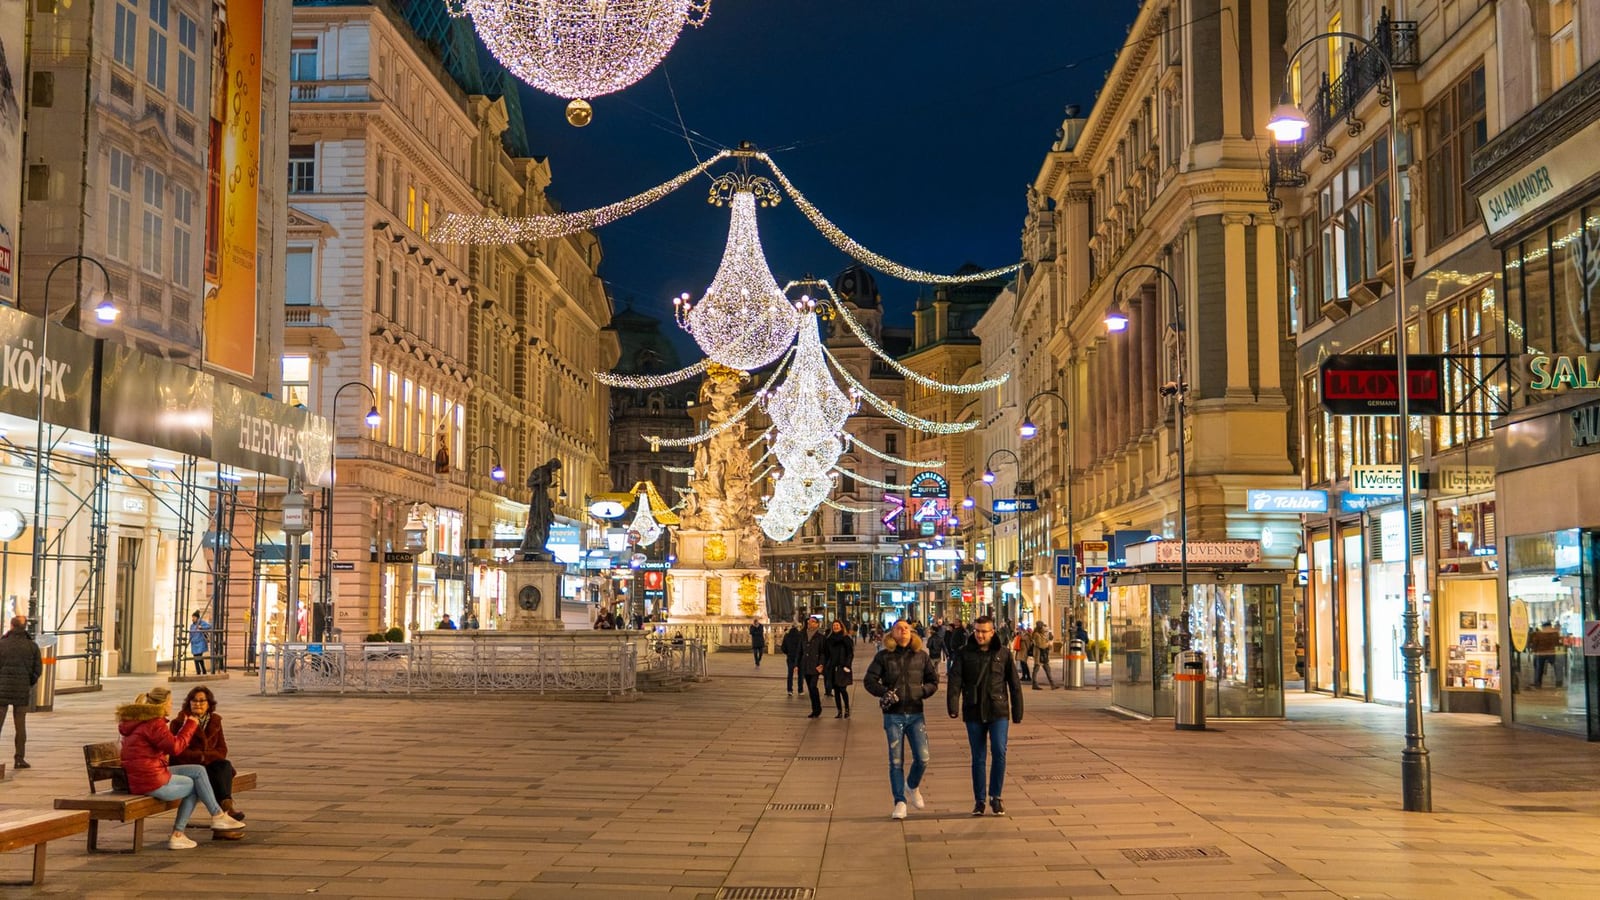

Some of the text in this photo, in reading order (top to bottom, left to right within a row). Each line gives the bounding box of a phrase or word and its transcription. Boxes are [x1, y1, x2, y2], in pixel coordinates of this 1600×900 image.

[1488, 166, 1554, 222] SALAMANDER
[3, 338, 67, 402] KÖCK
[1331, 375, 1432, 395] LLOYD
[1530, 355, 1600, 389] SAL
[239, 412, 304, 464] HERMÈS
[1570, 404, 1600, 448] SAL
[1365, 474, 1403, 484] Wolfor
[998, 501, 1032, 509] Berlitz
[1273, 496, 1322, 508] Tchibo
